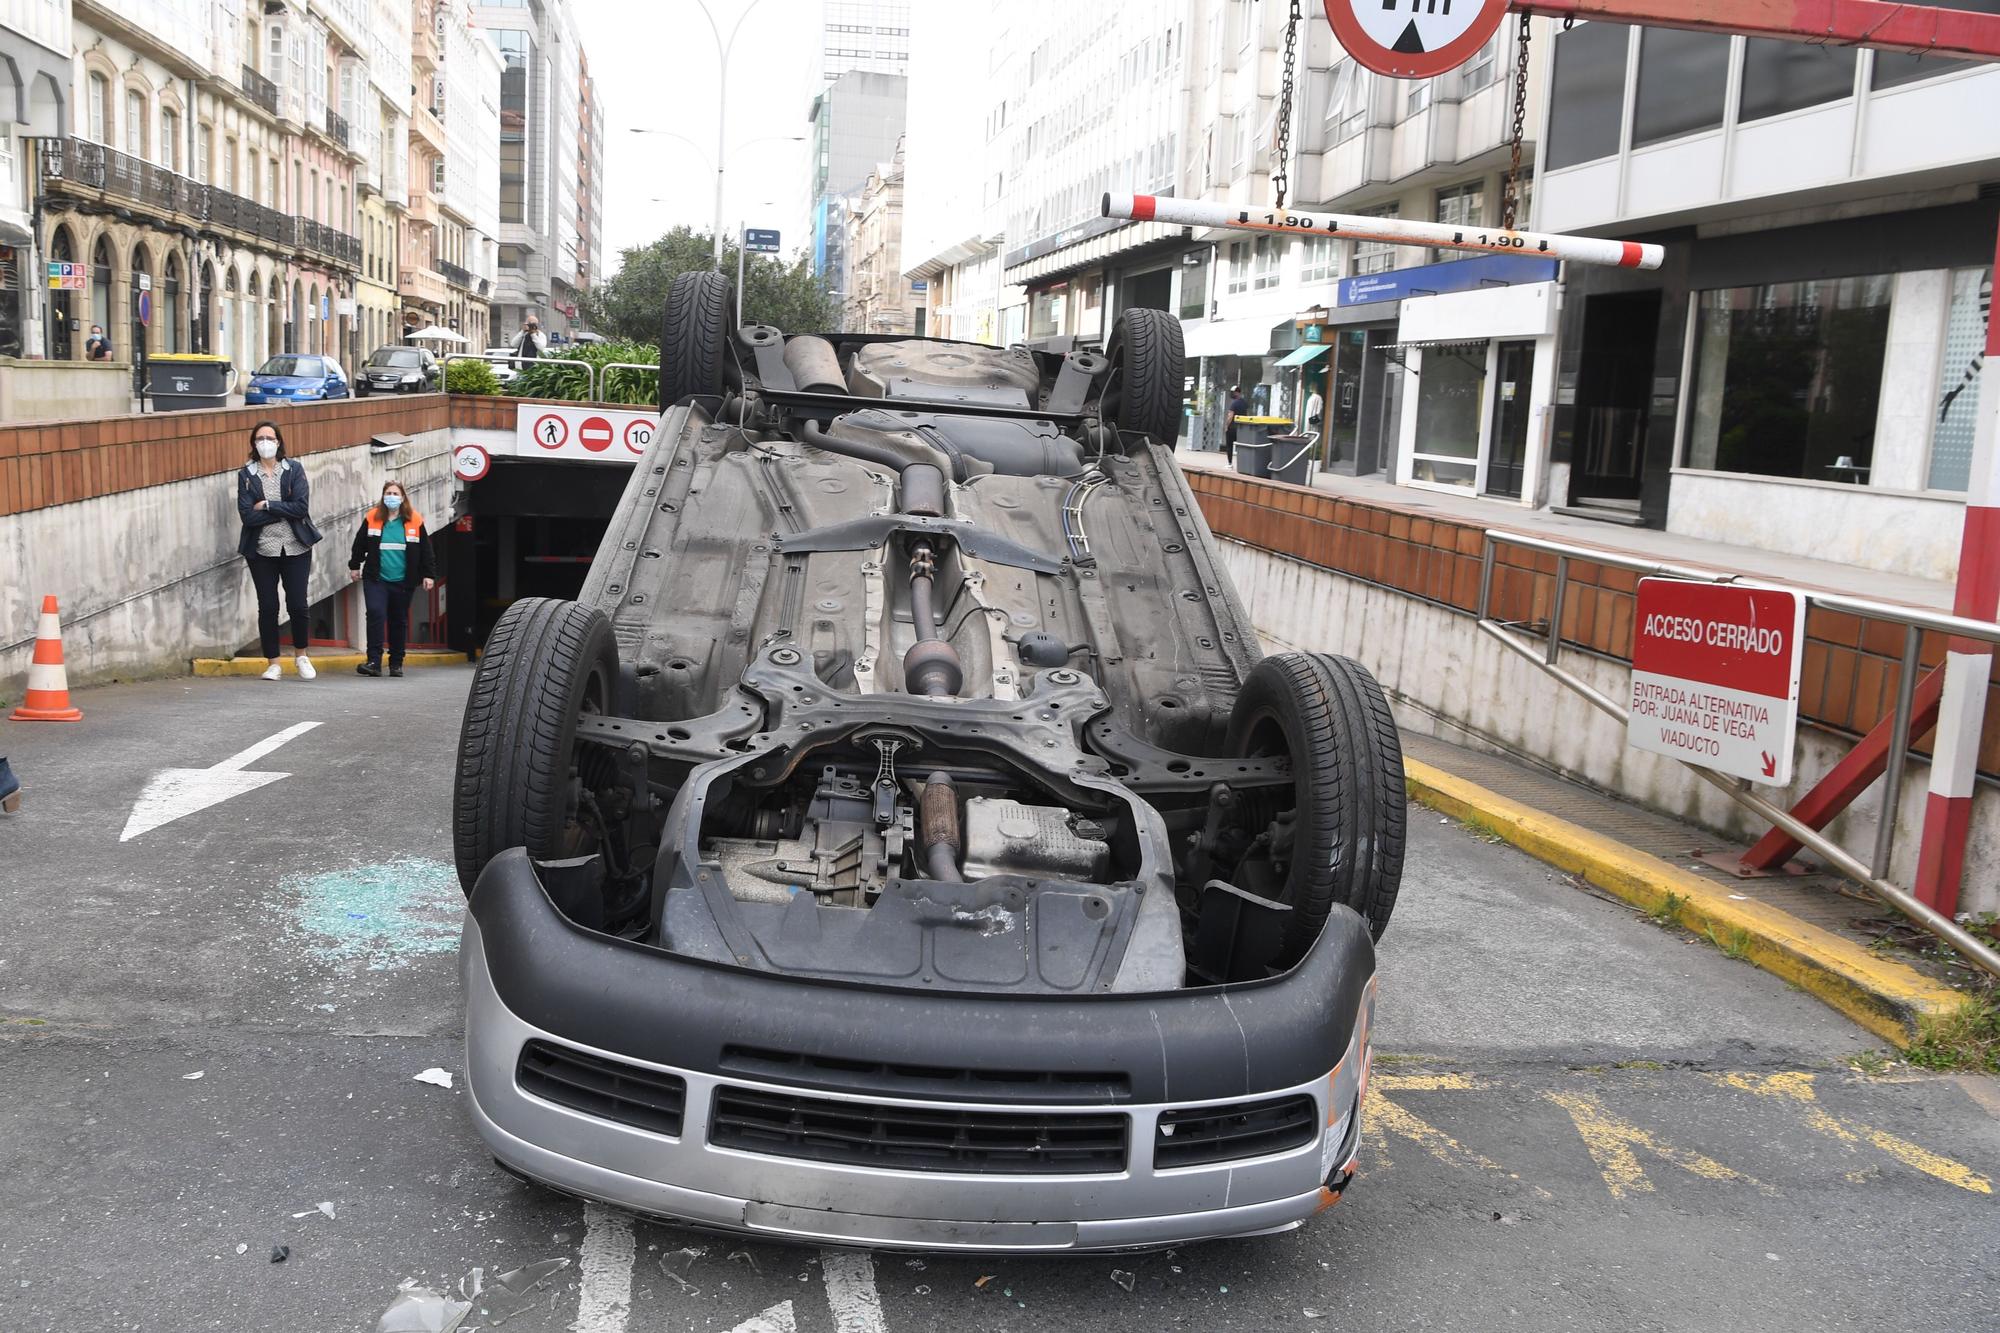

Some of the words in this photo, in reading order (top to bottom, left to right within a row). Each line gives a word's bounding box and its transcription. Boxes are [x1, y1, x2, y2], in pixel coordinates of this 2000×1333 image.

[1264, 214, 1313, 228] 1,90
[1478, 234, 1524, 248] 1,90
[63, 265, 70, 274] P
[632, 430, 651, 444] 10
[1643, 613, 1703, 644] ACCESO
[1706, 621, 1783, 656] CERRADO
[1634, 681, 1686, 706] ENTRADA
[1689, 693, 1769, 725] ALTERNATIVA
[1632, 698, 1659, 717] POR:
[1661, 705, 1700, 727] JUANA
[1703, 713, 1719, 732] DE
[1723, 718, 1756, 741] VEGA
[1660, 727, 1720, 756] VIADUCTO
